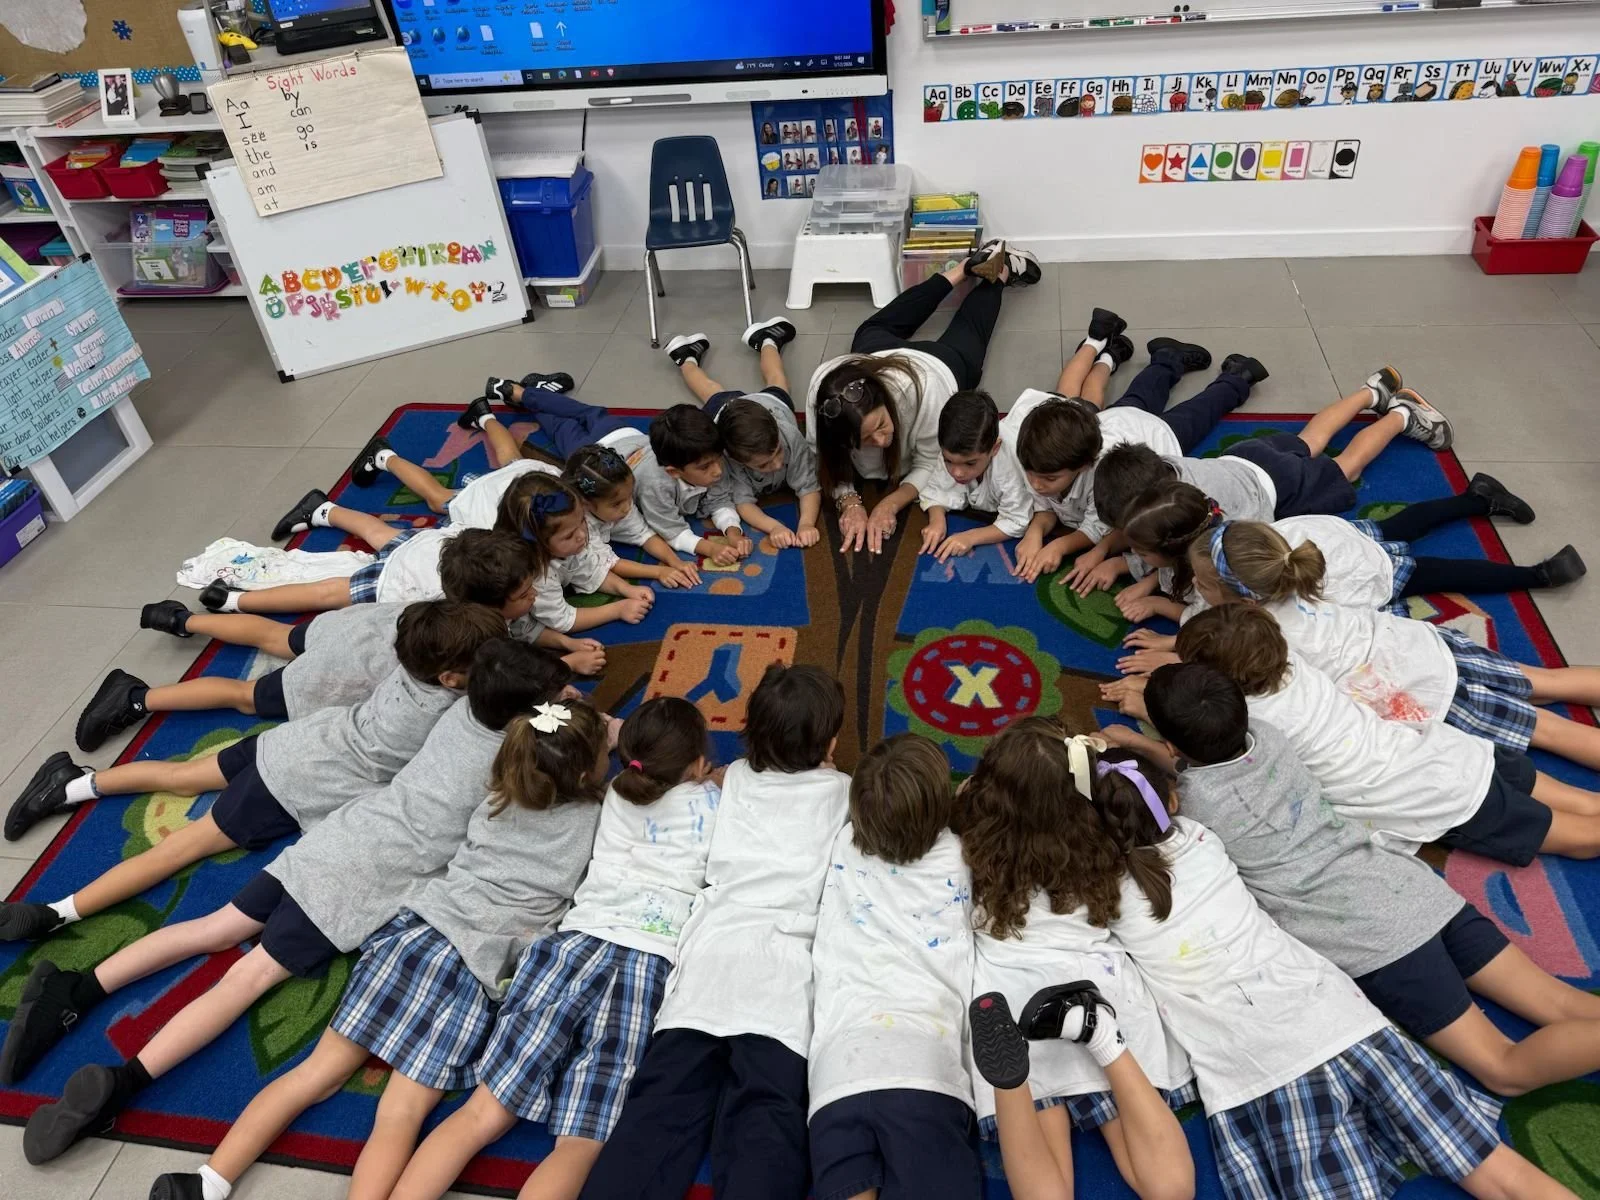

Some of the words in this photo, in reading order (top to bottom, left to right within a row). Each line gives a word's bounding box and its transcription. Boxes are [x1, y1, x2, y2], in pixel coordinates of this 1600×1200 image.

[267, 73, 304, 91] Sight
[310, 62, 357, 83] Words
[930, 89, 946, 100] Aa
[955, 86, 971, 98] Bb
[983, 86, 998, 98] Cc
[1009, 84, 1025, 96] Dd
[1036, 82, 1051, 94] Ee
[1061, 82, 1076, 94] Ff
[1087, 81, 1103, 95] Gg
[1112, 80, 1129, 92] Hh
[1144, 78, 1154, 90] Ii
[1171, 77, 1182, 91] Jj
[1196, 76, 1212, 88] Kk
[1227, 75, 1237, 87] Ll
[1247, 74, 1272, 86] Mm
[1277, 72, 1297, 85] Nn
[1307, 71, 1326, 84] Oo
[1336, 69, 1355, 84] Pp
[1364, 67, 1385, 82] Qq
[1394, 66, 1412, 79] Rr
[1425, 65, 1441, 78] Ss
[1456, 64, 1470, 77] Tt
[1484, 61, 1502, 74] Uu
[1513, 60, 1532, 73] Vv
[1539, 61, 1565, 73] Ww
[1571, 59, 1592, 72] Xx
[226, 98, 250, 113] Aa
[281, 87, 300, 107] by
[236, 112, 252, 129] I
[291, 107, 312, 118] can
[297, 124, 314, 140] go
[305, 139, 318, 151] is
[245, 149, 272, 164] the
[253, 162, 276, 179] and
[258, 184, 277, 196] am
[264, 199, 279, 211] at
[21, 348, 49, 370] leader
[3, 384, 25, 408] light
[27, 367, 53, 390] helper
[11, 408, 33, 425] flag
[29, 389, 56, 411] holder
[15, 430, 31, 445] door
[31, 409, 61, 433] holders
[4, 455, 22, 469] Our
[27, 435, 49, 456] ball
[47, 417, 77, 441] helpers
[686, 642, 742, 703] Y
[945, 660, 1003, 709] X
